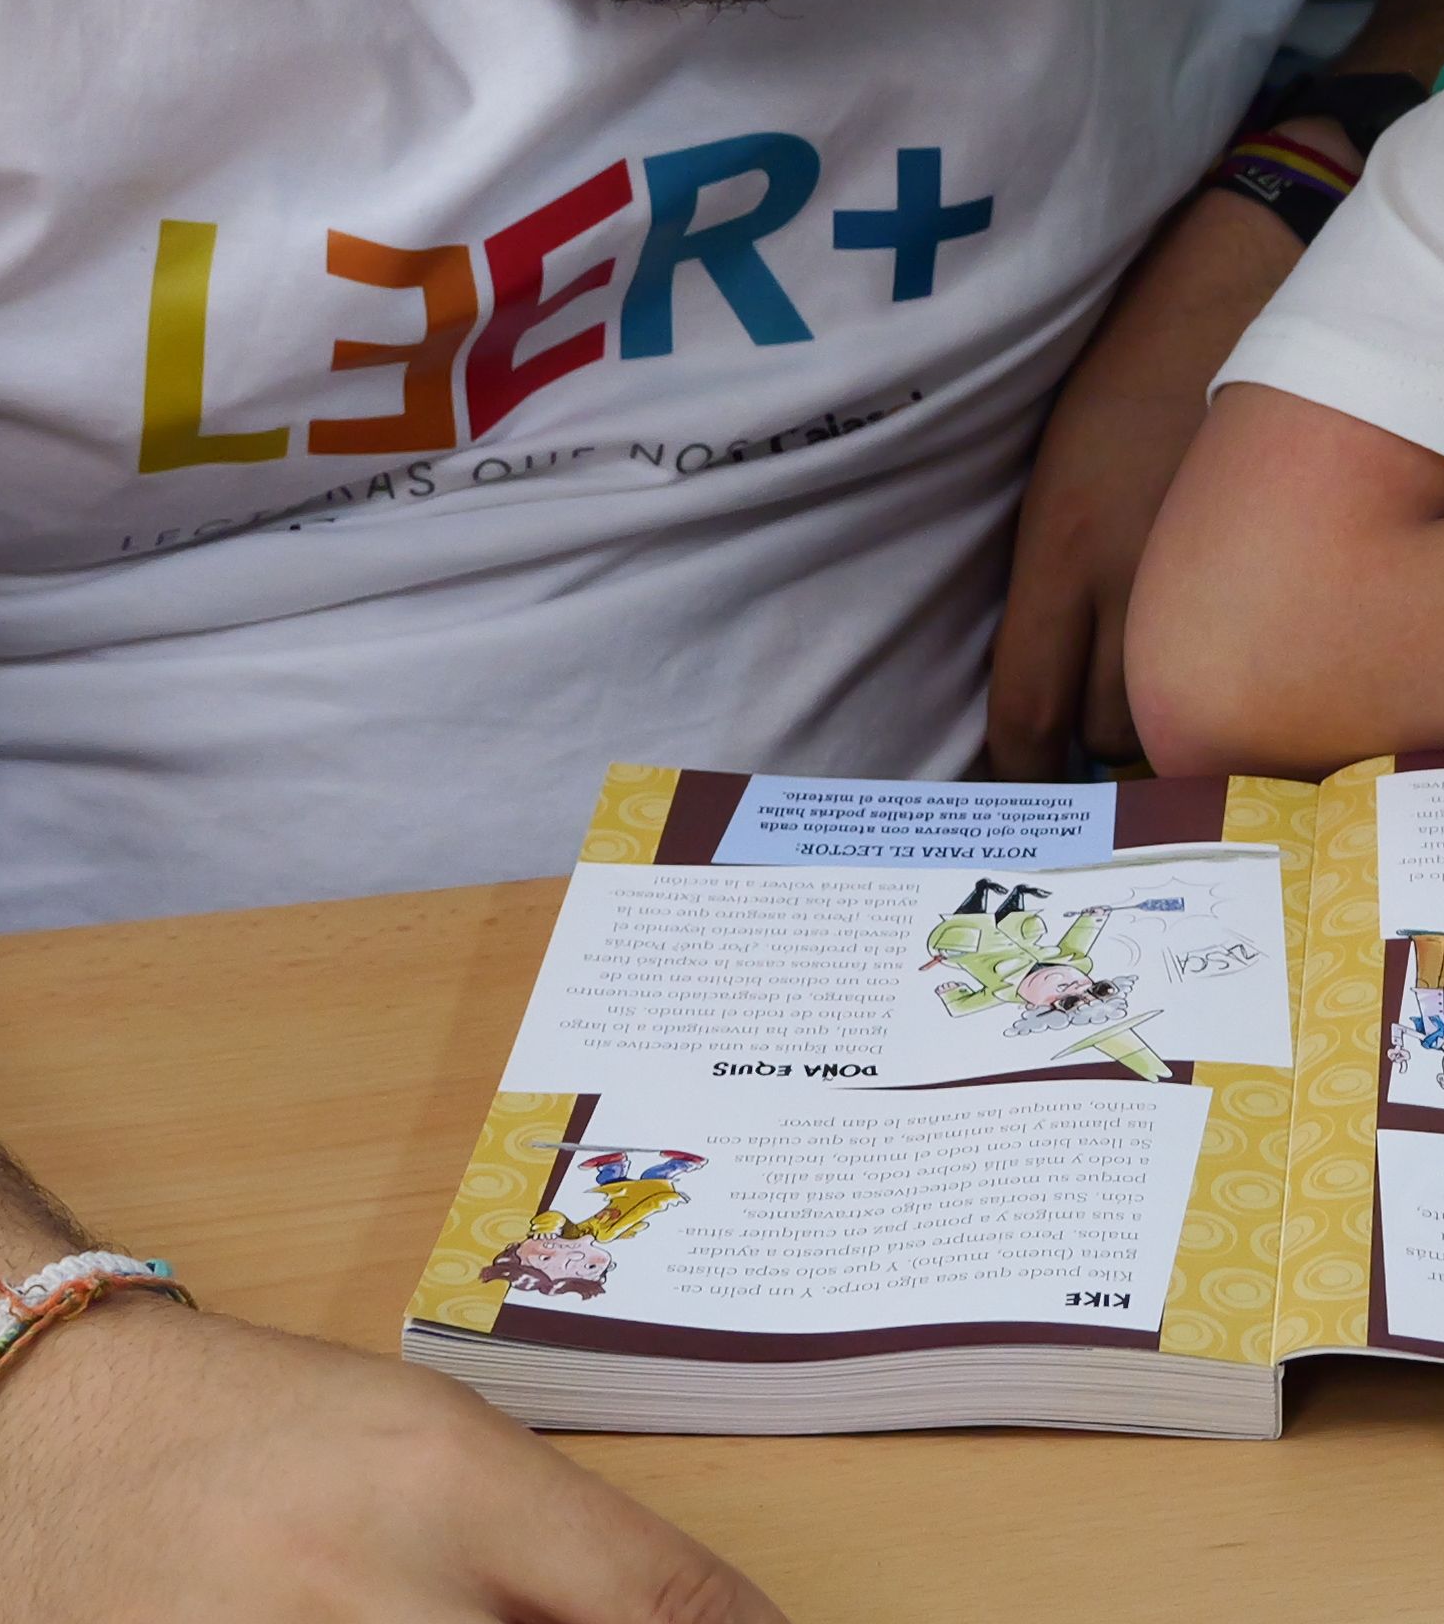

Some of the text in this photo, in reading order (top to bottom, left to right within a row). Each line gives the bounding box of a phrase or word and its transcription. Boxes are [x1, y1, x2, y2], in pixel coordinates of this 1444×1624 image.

[858, 796, 874, 806] el
[877, 796, 923, 807] sobre
[926, 797, 970, 808] clave
[974, 798, 1074, 810] información
[757, 807, 807, 819] hallar
[809, 808, 867, 820] podrás
[869, 811, 936, 823] detalles
[760, 823, 800, 833] cada
[803, 824, 877, 836] atención
[880, 826, 911, 834] con
[914, 827, 983, 839] Observa
[1020, 826, 1083, 838] ¡Mucho
[889, 845, 917, 857] EL
[921, 846, 977, 858] PARA
[981, 847, 1039, 859] NOTA
[560, 1018, 607, 1032] largo
[652, 1022, 760, 1036] investigado
[795, 1024, 830, 1034] que
[584, 1039, 612, 1049] sin
[617, 1040, 703, 1052] detective
[709, 1042, 744, 1050] una
[776, 1041, 828, 1054] Equis
[835, 1044, 884, 1055] Doña
[711, 1062, 879, 1082] DOÑA EQUIS
[978, 1176, 1041, 1189] mente
[1076, 1172, 1147, 1182] porque
[852, 1182, 973, 1198] detectivesca
[730, 1192, 801, 1203] abierta
[807, 1192, 846, 1203] está
[939, 1199, 974, 1208] son
[980, 1194, 1047, 1206] teorías
[1054, 1193, 1089, 1204] Sus
[891, 1202, 933, 1215] algo
[914, 1214, 974, 1229] poner
[996, 1211, 1008, 1221] y
[1014, 1209, 1086, 1222] amigos
[844, 1228, 869, 1236] en
[874, 1220, 908, 1233] paz
[739, 1227, 838, 1241] cualquier
[932, 1233, 1014, 1246] siempre
[1020, 1231, 1065, 1242] Pero
[688, 1245, 761, 1259] ayudar
[783, 1245, 881, 1260] dispuesto
[887, 1240, 927, 1254] está
[1082, 1248, 1138, 1261] gueta
[667, 1266, 739, 1278] chistes
[744, 1265, 790, 1275] sepa
[843, 1261, 882, 1273] que
[886, 1263, 899, 1273] Y
[974, 1267, 1013, 1278] que
[1018, 1266, 1082, 1280] puede
[796, 1268, 838, 1279] solo
[936, 1273, 969, 1282] sea
[1088, 1270, 1133, 1282] Kike
[887, 1276, 930, 1289] algo
[710, 1285, 762, 1298] pelín
[802, 1288, 813, 1298] Y
[1064, 1291, 1132, 1309] KIKE
